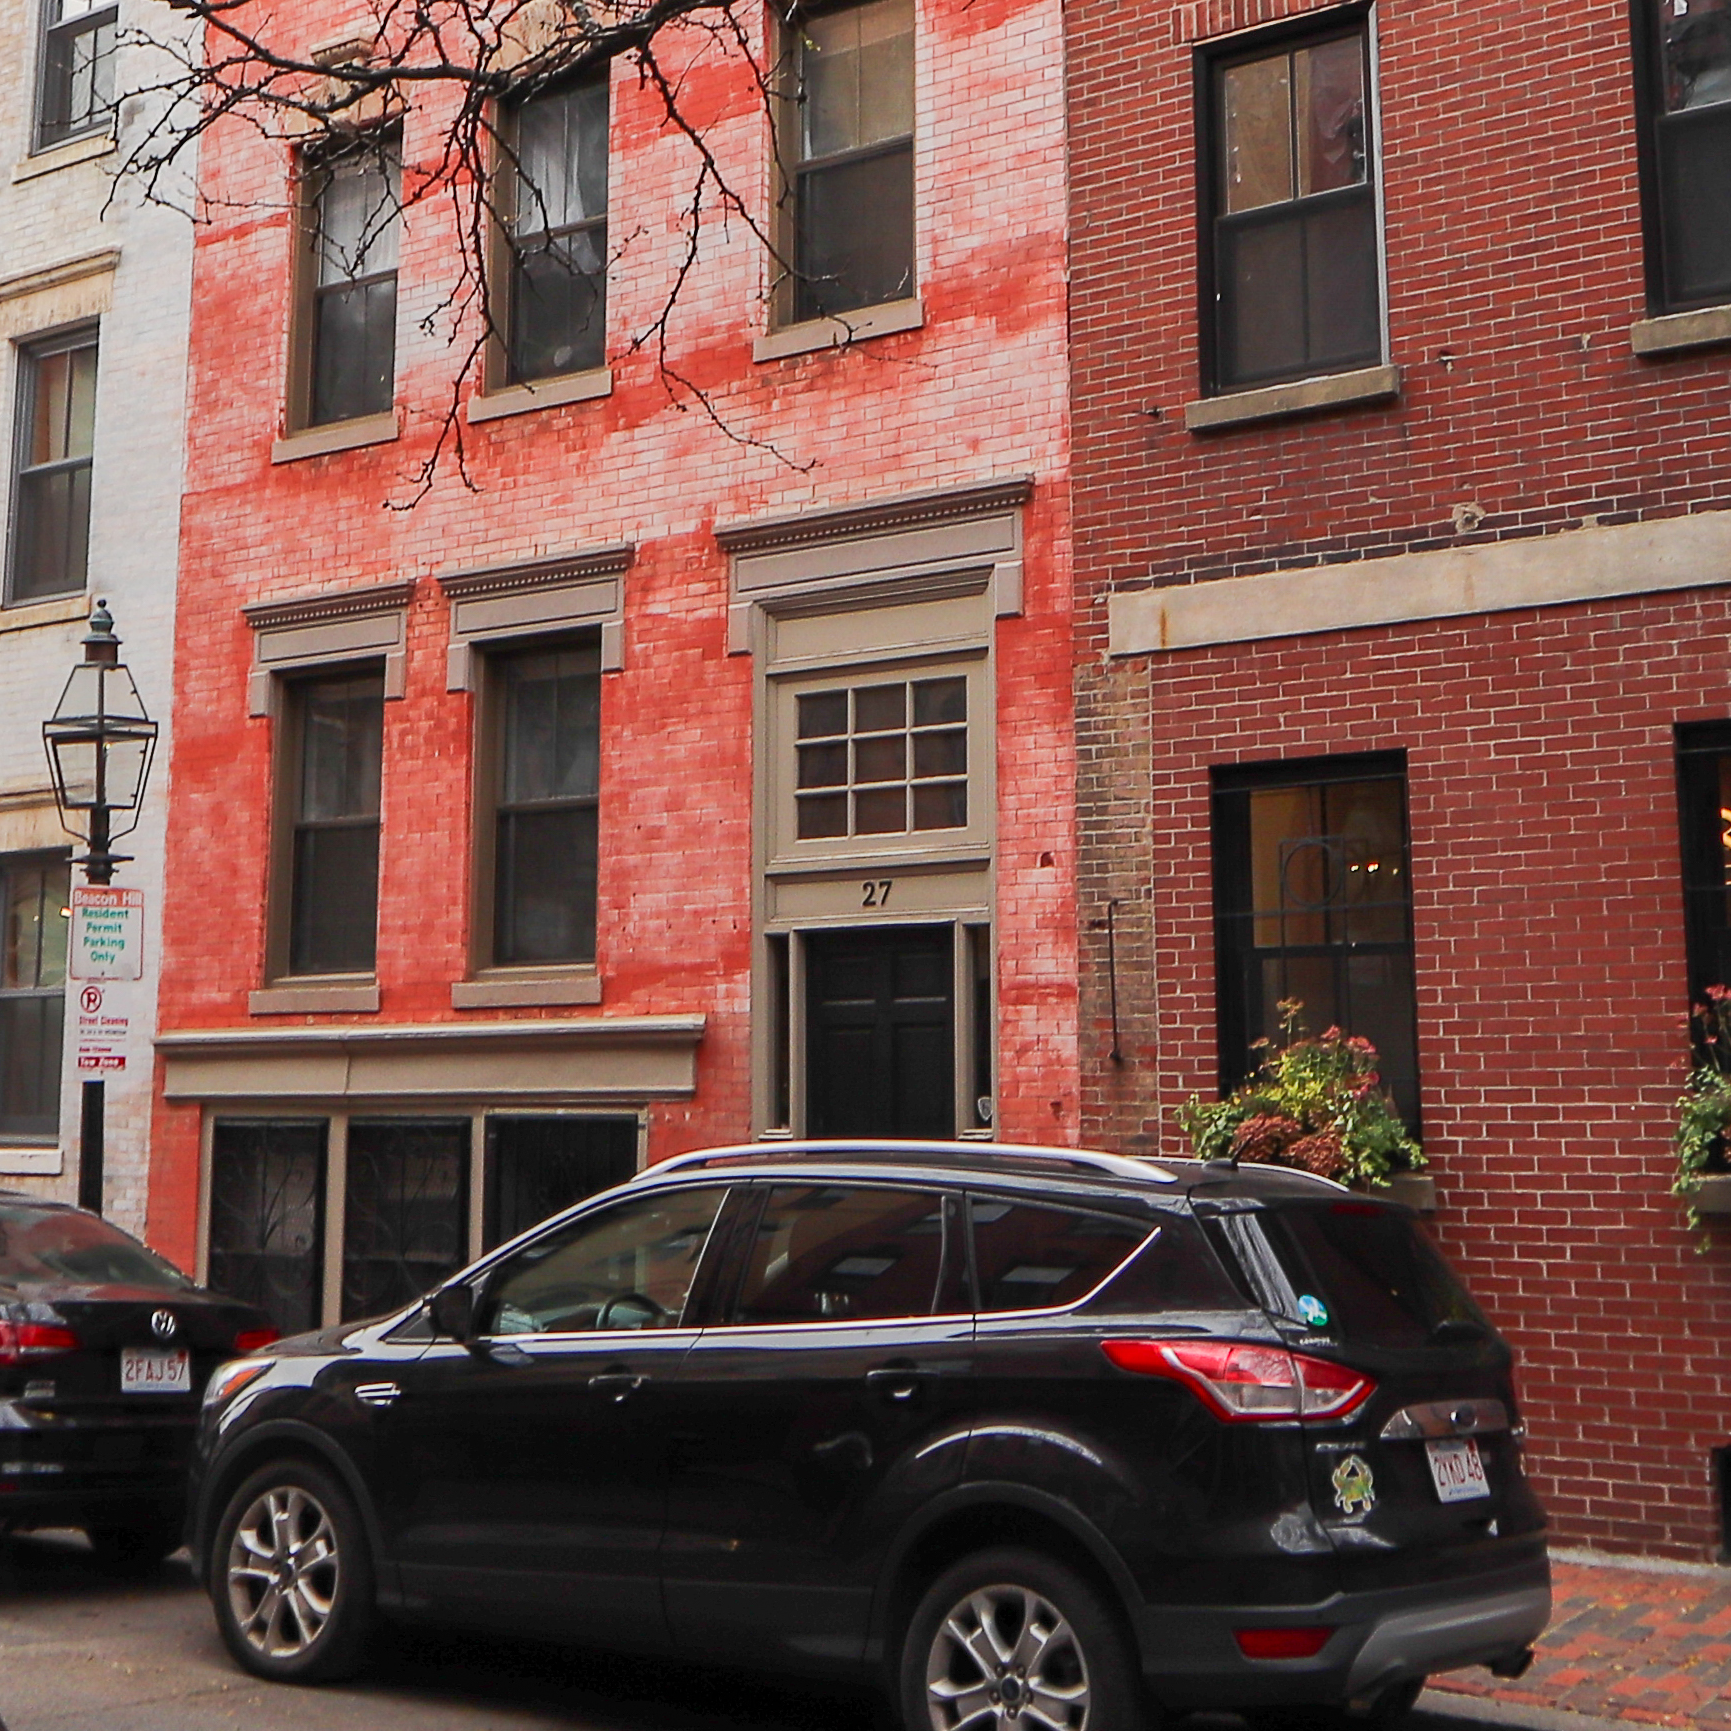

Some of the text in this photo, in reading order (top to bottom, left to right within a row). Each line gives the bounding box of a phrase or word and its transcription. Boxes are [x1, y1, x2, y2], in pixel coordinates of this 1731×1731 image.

[74, 890, 142, 906] Beacon Hill
[862, 879, 893, 907] 27
[82, 908, 129, 919] Resident
[86, 922, 122, 933] Permit
[83, 936, 125, 951] Parking
[90, 951, 116, 965] Only
